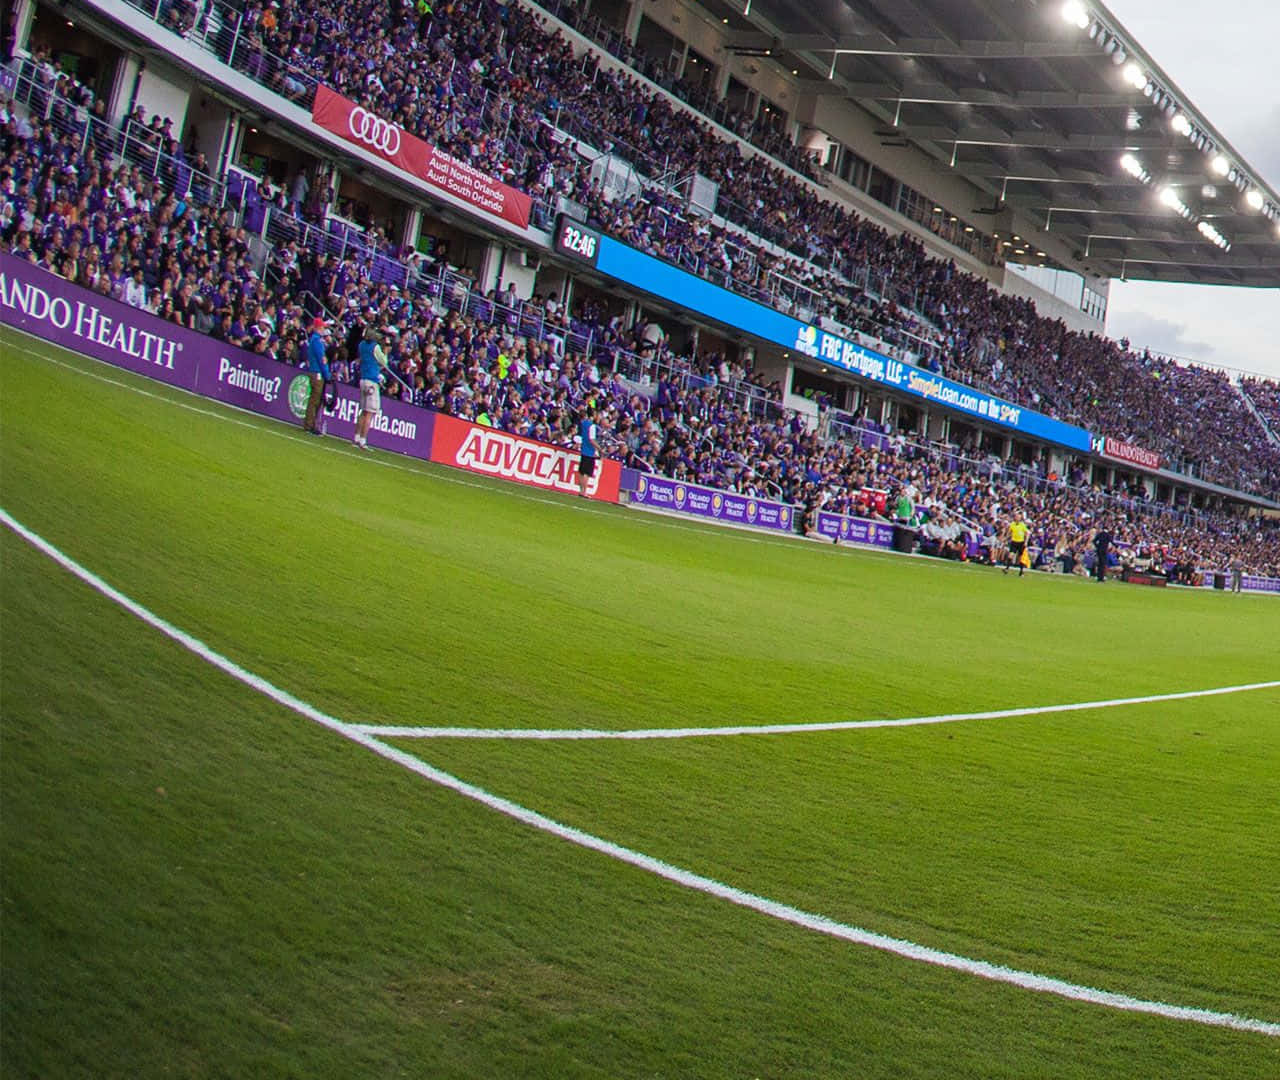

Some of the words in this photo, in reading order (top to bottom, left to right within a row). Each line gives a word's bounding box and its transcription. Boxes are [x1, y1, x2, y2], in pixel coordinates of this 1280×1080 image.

[432, 147, 450, 162] Audi
[427, 170, 446, 184] Audi
[449, 178, 471, 197] South
[472, 191, 503, 213] Orlando
[429, 158, 448, 173] Audi
[451, 167, 473, 185] North
[474, 180, 504, 202] Orlando
[564, 227, 596, 258] 32:46
[73, 301, 176, 369] HEALTH
[218, 358, 281, 402] Painting?
[821, 334, 842, 361] FBC
[886, 359, 903, 384] LLC
[907, 369, 978, 413] SimpleLoan.com
[1000, 404, 1020, 425] SPT
